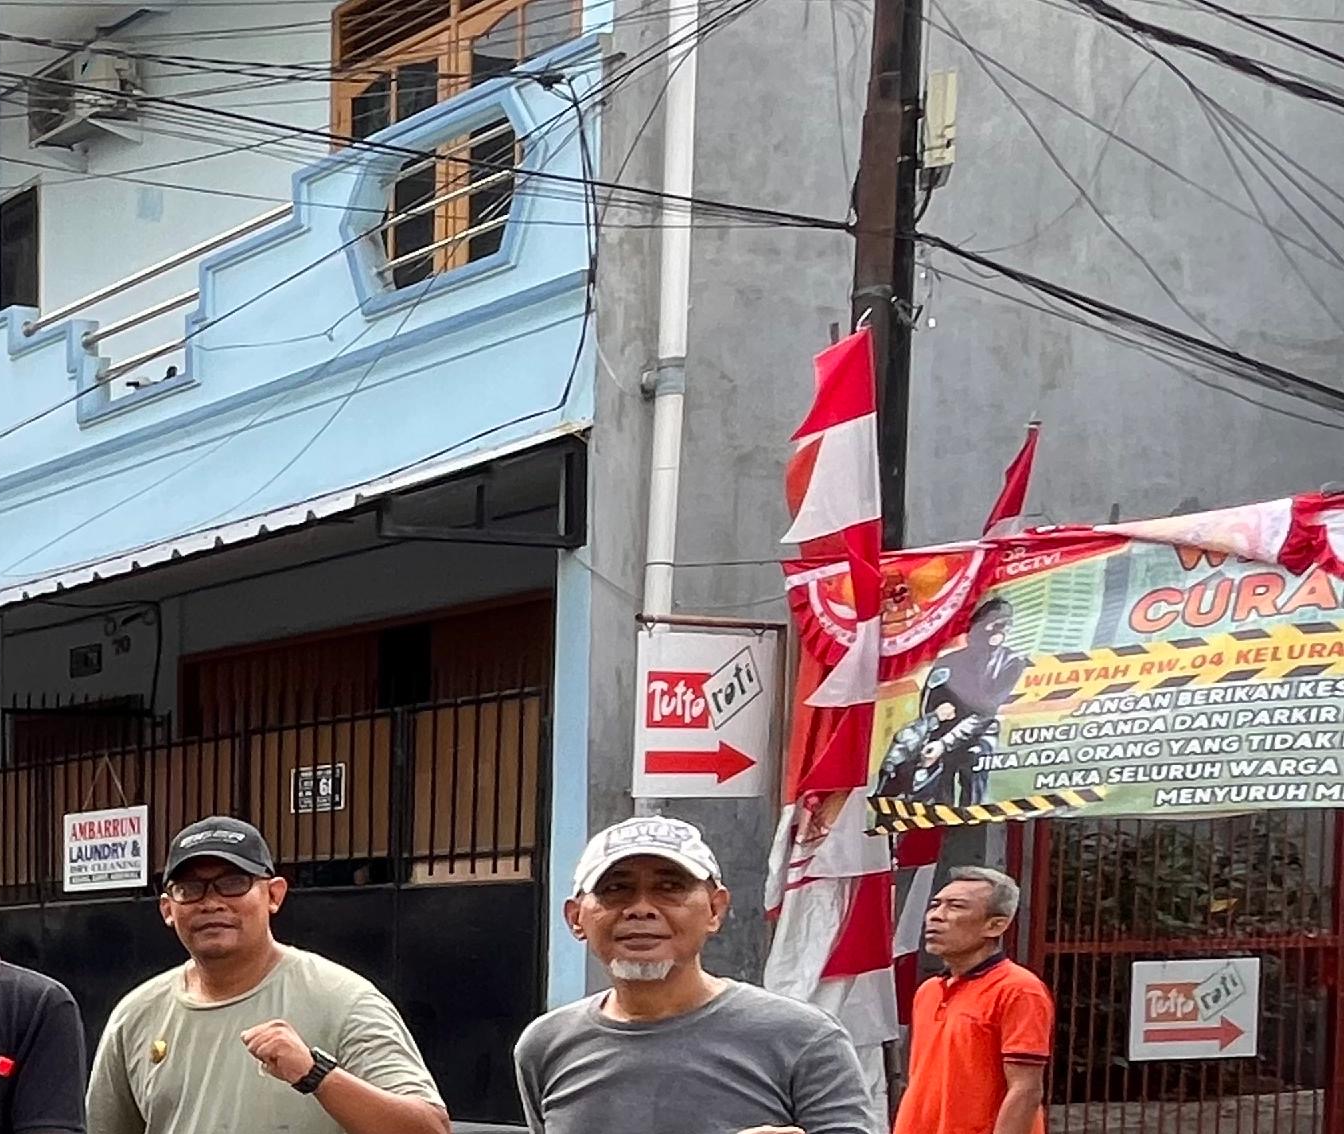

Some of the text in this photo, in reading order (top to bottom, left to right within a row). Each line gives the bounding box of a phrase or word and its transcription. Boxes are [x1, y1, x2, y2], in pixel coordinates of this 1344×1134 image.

[1128, 563, 1344, 634] CURA
[1024, 664, 1131, 688] WILAYAH
[1139, 651, 1224, 676] RW.04
[649, 662, 754, 724] Tutto roti
[1074, 692, 1171, 716] JANGAN
[1177, 682, 1291, 706] BERIKAN
[1010, 706, 1338, 746] KUNCI GANDA DAN PARKIR
[972, 731, 1334, 772] JIKA ADA ORANG YANG TIDAK
[1035, 757, 1339, 788] MAKA SELURUH WARGA
[1156, 783, 1344, 806] MENYURUH M
[71, 817, 141, 841] AMBARRUNI
[69, 840, 141, 863] LAUNDRY &
[1146, 988, 1194, 1018] Tutto
